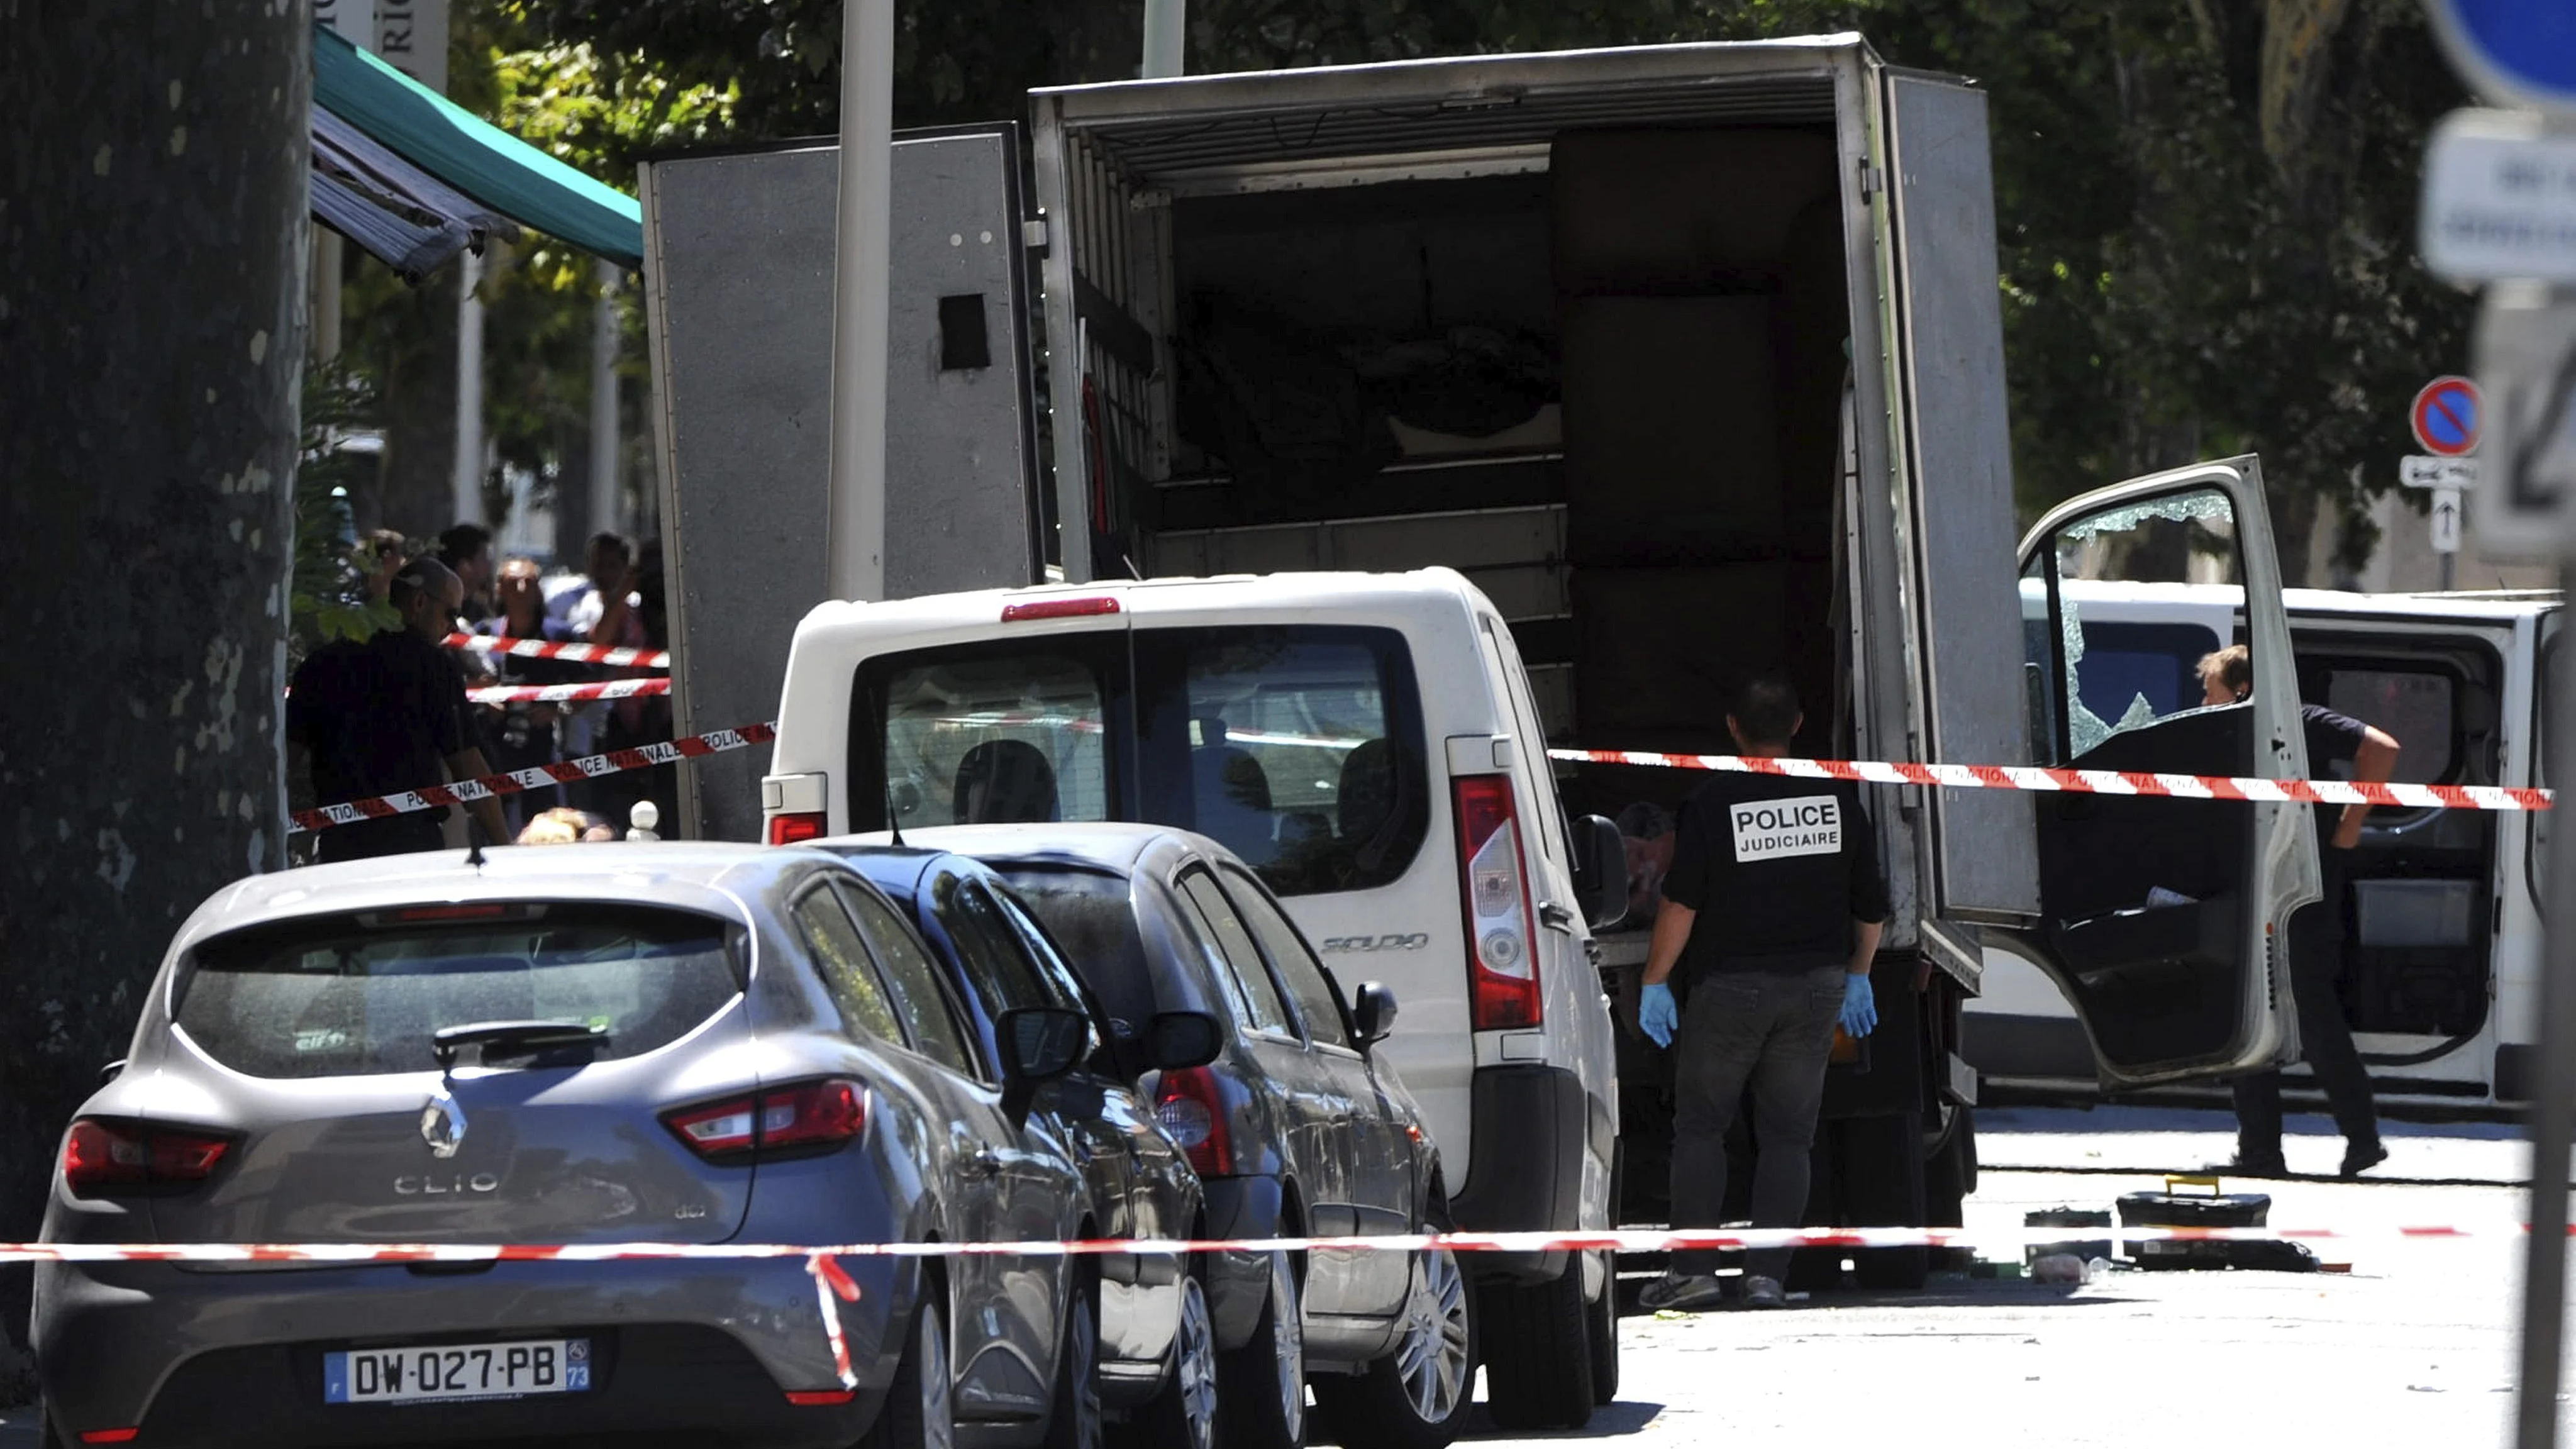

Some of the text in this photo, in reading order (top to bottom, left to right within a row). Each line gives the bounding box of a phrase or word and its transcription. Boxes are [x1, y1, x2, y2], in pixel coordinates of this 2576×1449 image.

[406, 784, 453, 807] POLICE
[457, 770, 533, 799] NATIONALE
[555, 756, 601, 779] POLICE
[606, 740, 680, 769] NATIONALE
[703, 727, 750, 750] POLICE
[1736, 804, 1836, 833] POLICE
[1741, 831, 1838, 852] JUDICIAIRE
[394, 1172, 498, 1194] CLIO
[331, 1346, 589, 1395] F DW-027-PB 73
